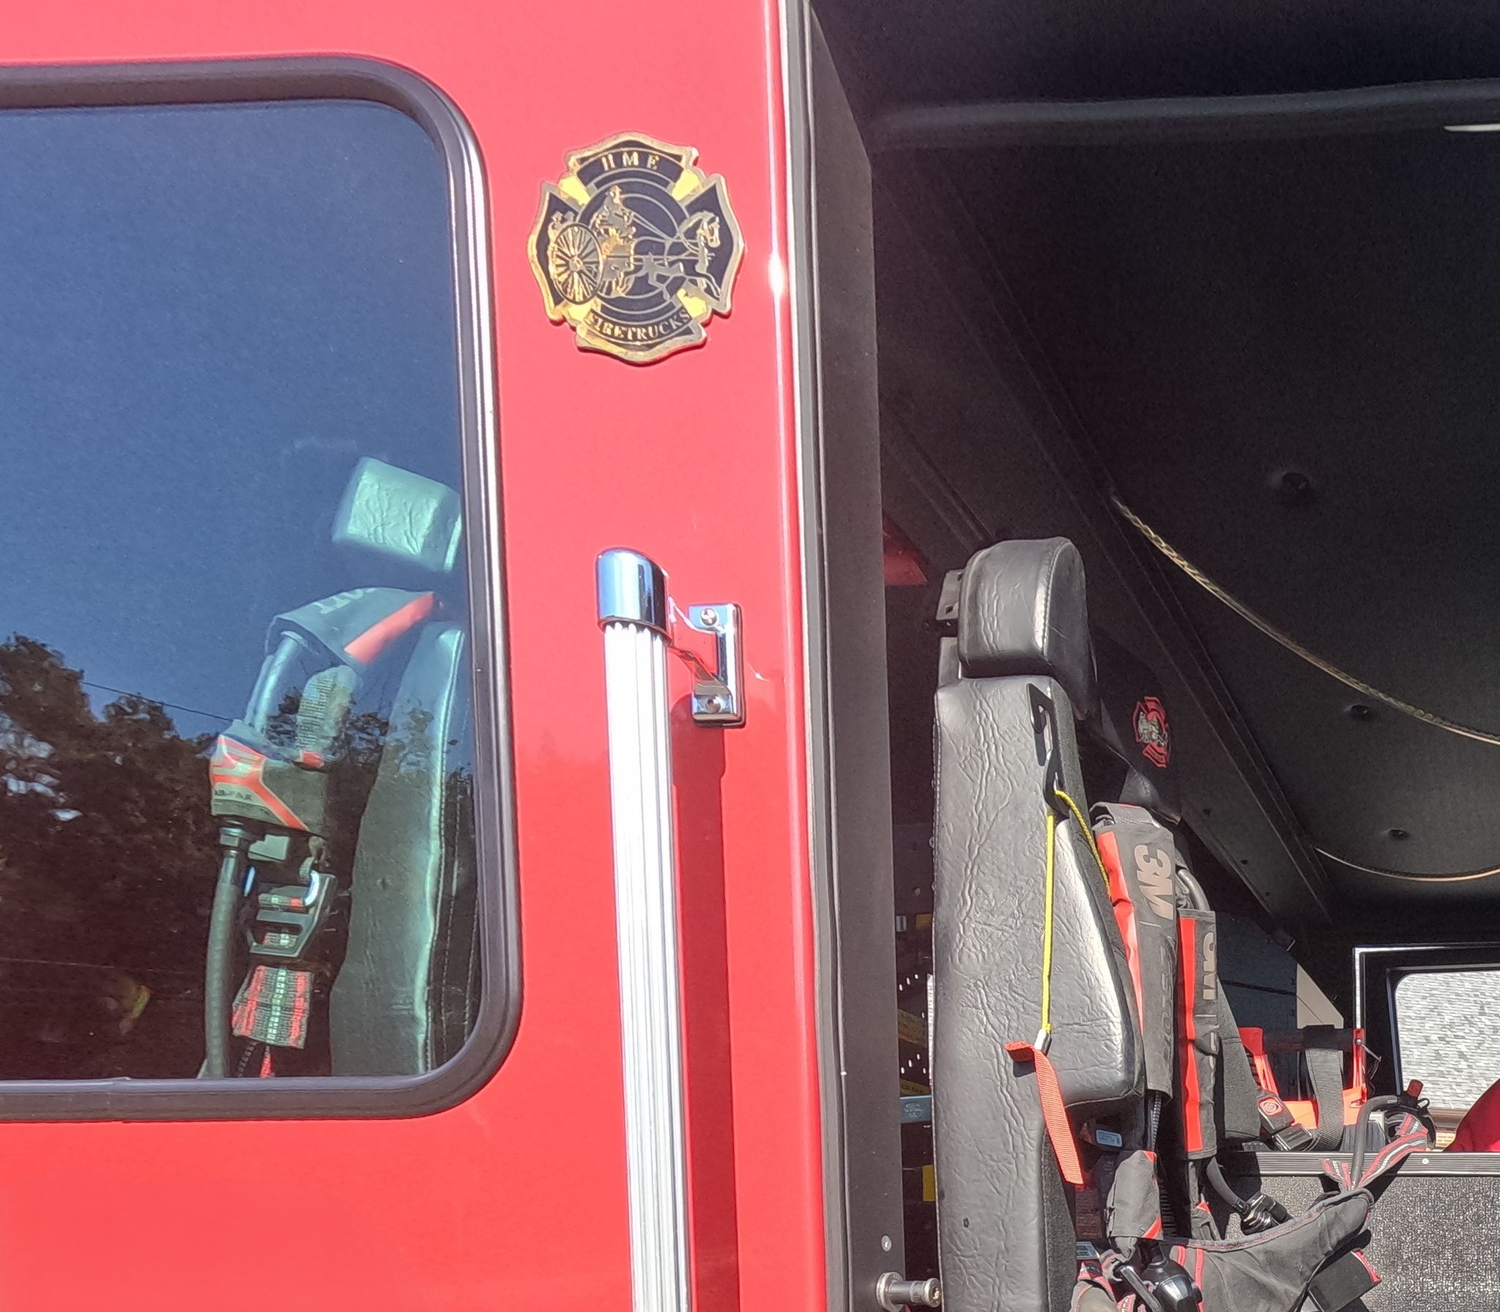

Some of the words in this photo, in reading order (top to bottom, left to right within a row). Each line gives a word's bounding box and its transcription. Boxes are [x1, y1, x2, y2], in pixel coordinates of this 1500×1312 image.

[601, 150, 660, 171] HME
[585, 309, 691, 341] FIRETRUCKS
[1134, 843, 1174, 921] 3M
